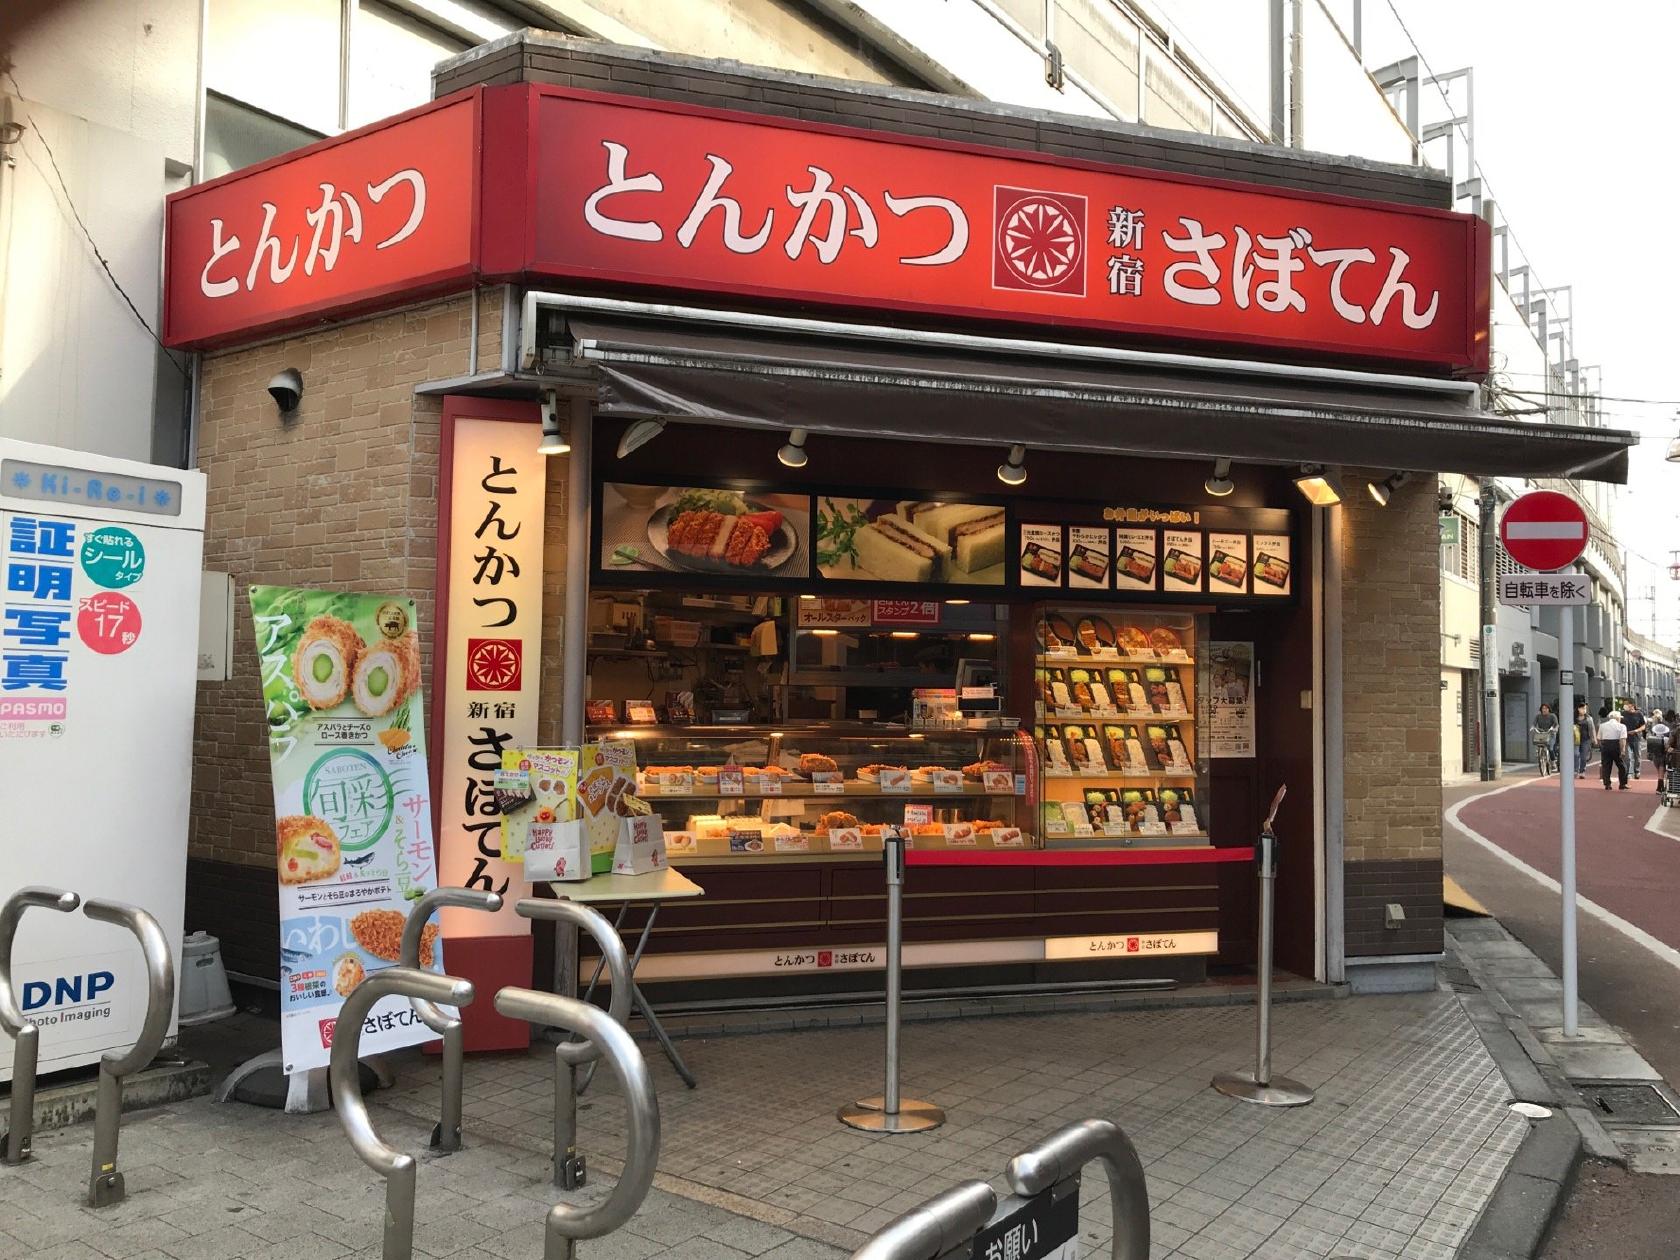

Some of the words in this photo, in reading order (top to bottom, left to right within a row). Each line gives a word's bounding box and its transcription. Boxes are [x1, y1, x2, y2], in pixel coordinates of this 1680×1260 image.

[200, 167, 428, 299] とんかつ
[582, 140, 970, 266] とんかつ
[1107, 205, 1145, 297] 新宿
[1162, 216, 1440, 331] さぼてん
[472, 456, 522, 628] とんかつ
[85, 547, 143, 570] シール
[115, 571, 143, 581] タイプ
[1505, 581, 1586, 599] 自転車を除く
[2, 516, 75, 691] 証明写真
[80, 598, 130, 614] スピード
[94, 614, 124, 638] 17
[0, 702, 65, 715] PASMO
[467, 701, 516, 719] 新宿
[338, 820, 375, 842] フェア
[402, 794, 433, 882] サーモン
[1089, 941, 1124, 951] とんかつ
[1145, 938, 1176, 949] さぼてん
[774, 954, 815, 966] とんかつ
[840, 952, 875, 963] さぼてん
[22, 971, 115, 1011] DNP
[61, 1006, 111, 1023] Imaging
